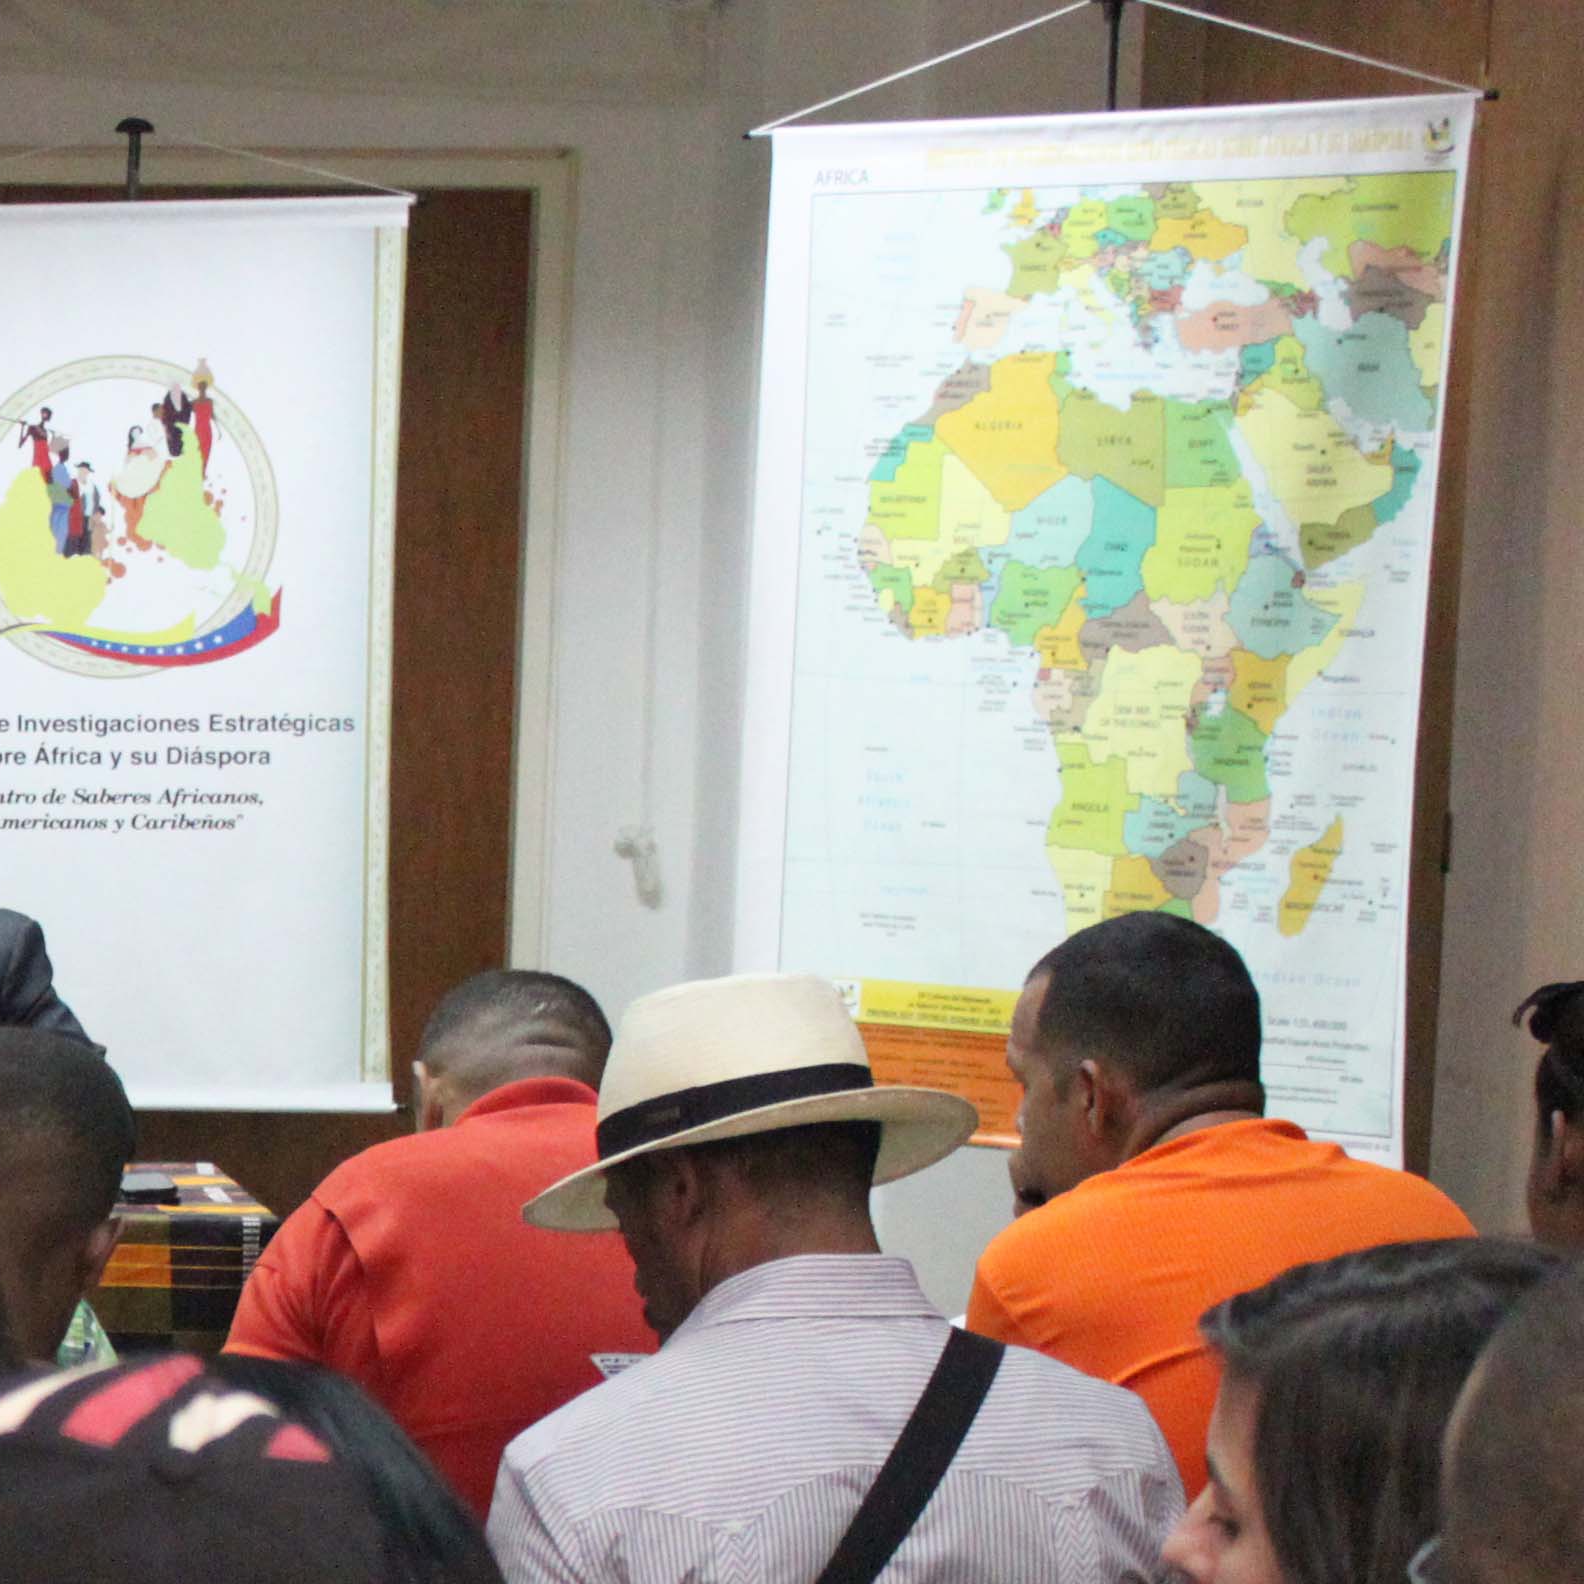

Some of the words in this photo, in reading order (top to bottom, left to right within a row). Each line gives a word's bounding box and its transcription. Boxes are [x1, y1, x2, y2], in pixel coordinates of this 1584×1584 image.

[814, 170, 869, 185] AFRICA
[17, 714, 200, 737] Investigaciones
[209, 713, 355, 737] Estratégicas
[34, 742, 102, 765] África
[110, 751, 122, 769] y
[131, 750, 157, 765] su
[166, 745, 271, 768] Diáspora
[42, 787, 66, 804] de
[72, 787, 151, 805] Saberes
[157, 787, 264, 808] Africanos,
[113, 817, 125, 834] y
[131, 812, 244, 831] Caribeños"
